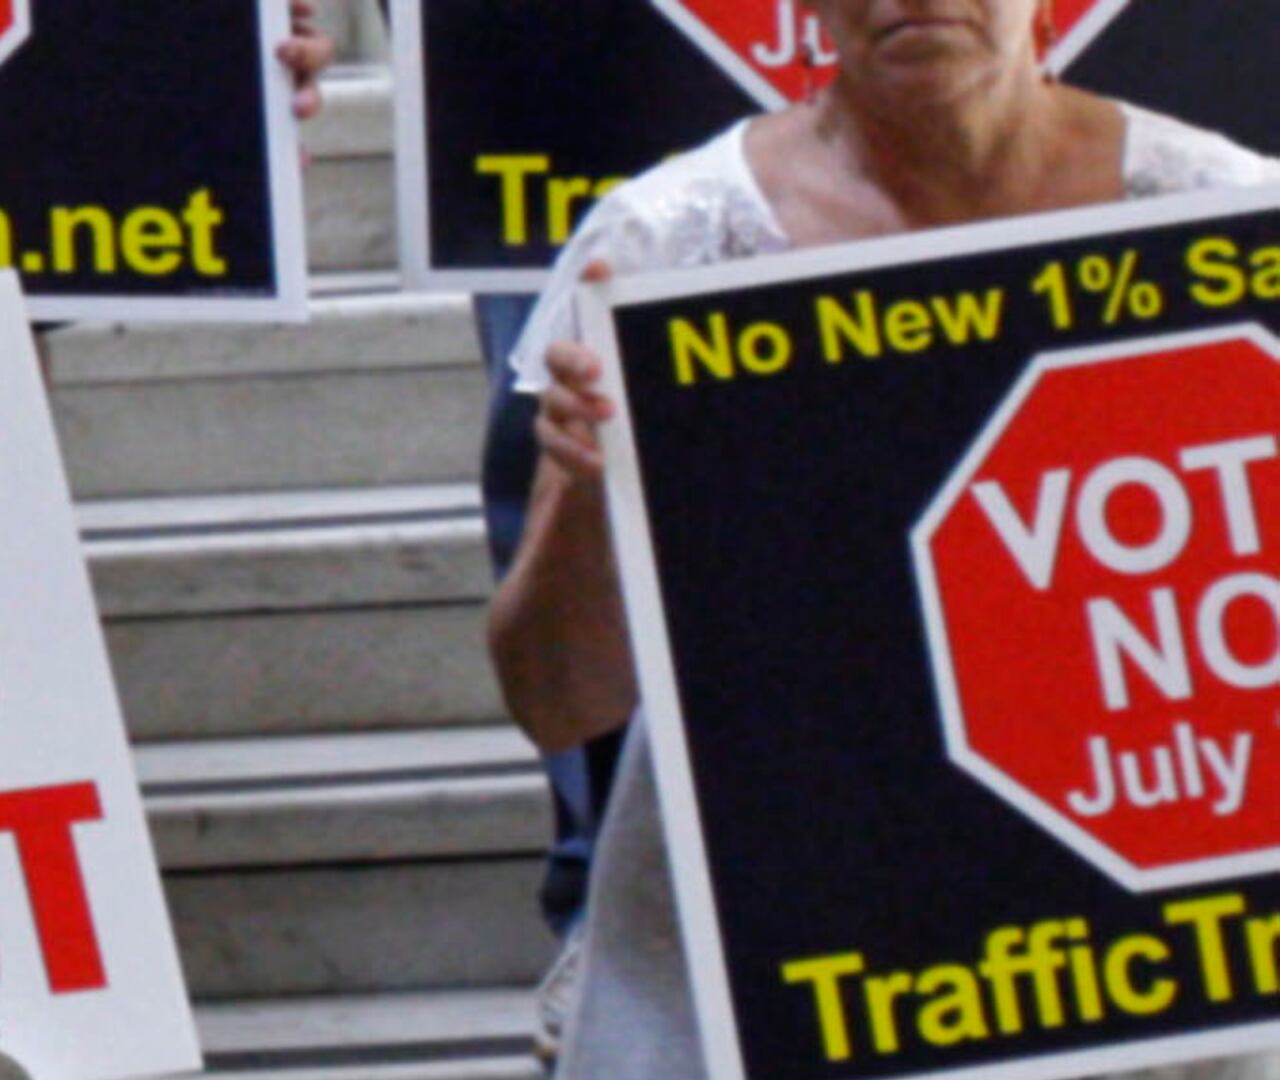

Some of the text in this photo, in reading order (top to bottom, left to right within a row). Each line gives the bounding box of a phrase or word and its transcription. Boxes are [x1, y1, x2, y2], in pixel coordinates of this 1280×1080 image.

[669, 312, 791, 386] No
[816, 289, 1003, 363] New
[1032, 250, 1162, 330] 1%
[1086, 572, 1280, 711] NO
[1067, 721, 1252, 817] July
